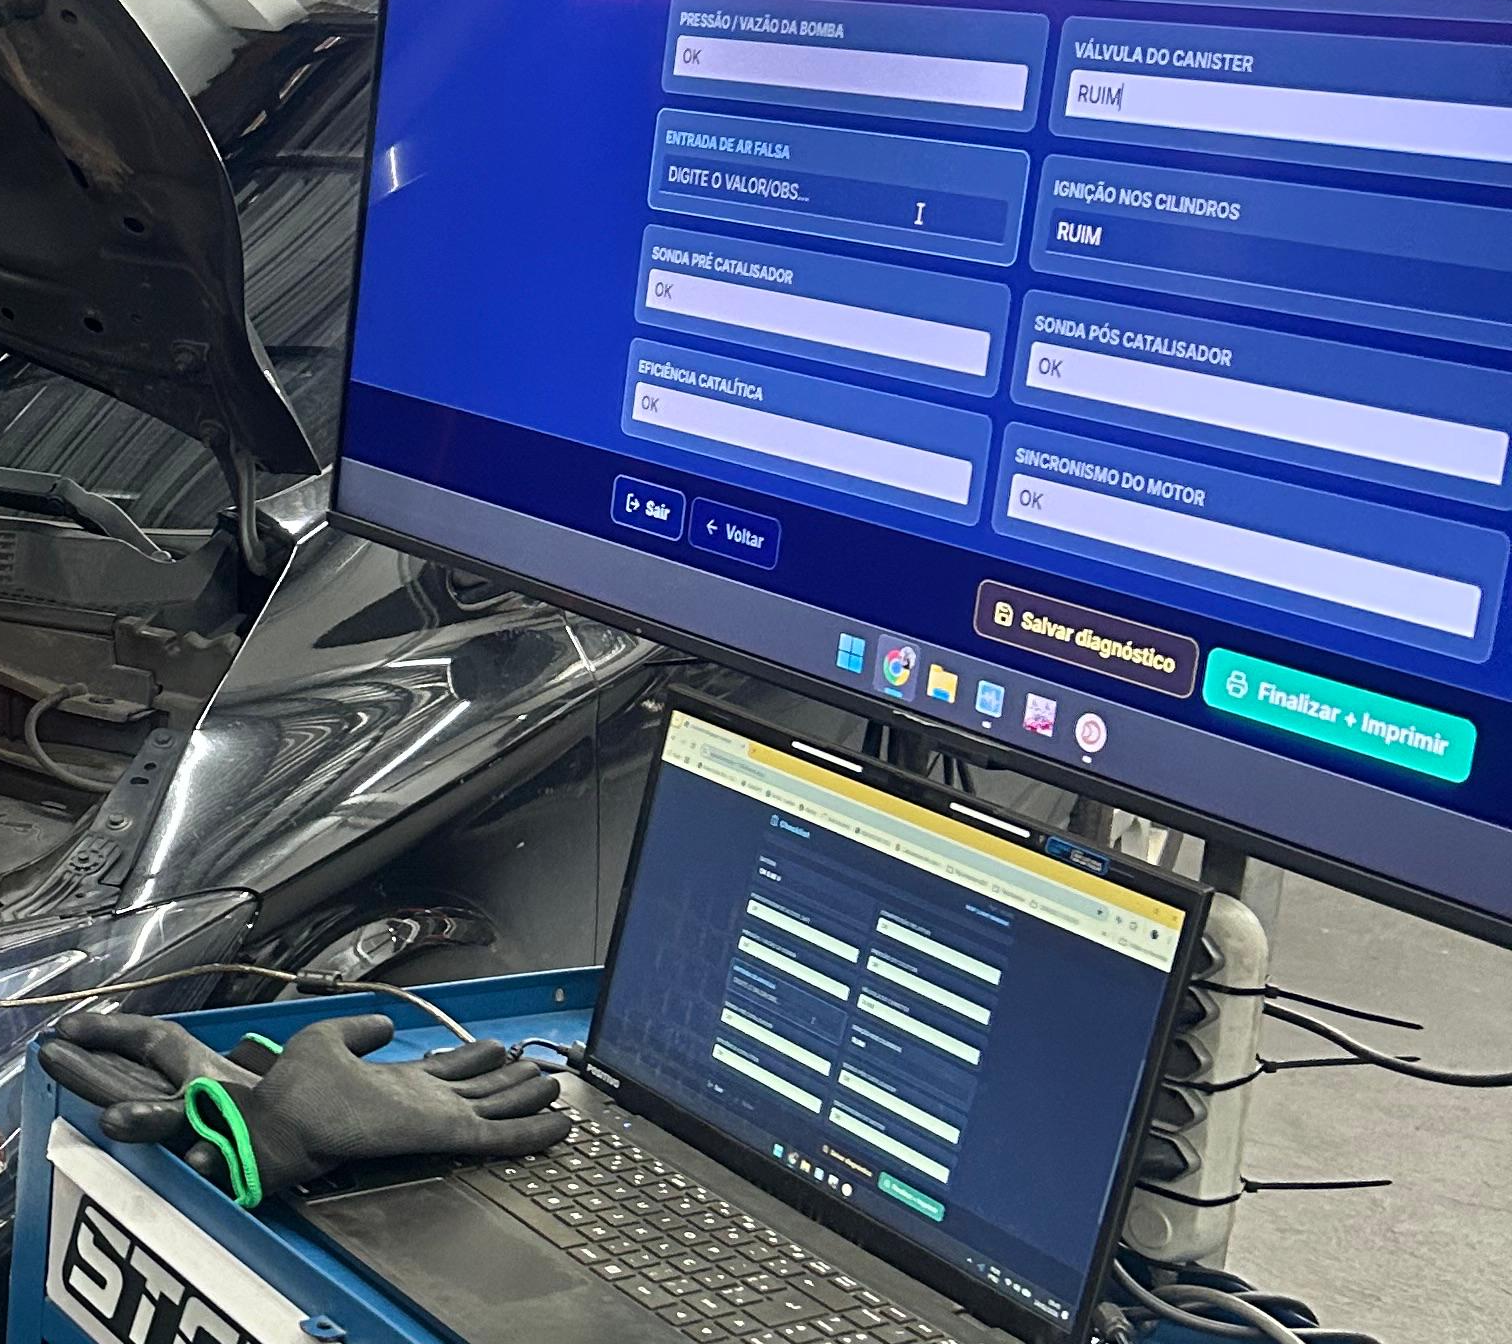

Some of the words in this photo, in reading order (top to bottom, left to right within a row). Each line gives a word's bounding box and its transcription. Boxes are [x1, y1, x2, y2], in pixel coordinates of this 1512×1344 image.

[679, 10, 731, 30] PRESSÃO
[738, 13, 778, 34] VAZÃO
[780, 18, 798, 35] DA
[799, 21, 844, 39] BOMBA
[682, 47, 701, 65] OK
[1075, 37, 1143, 64] VÁLVULA
[1145, 48, 1170, 66] DO
[1172, 49, 1254, 73] CANISTER
[1077, 83, 1123, 108] RUIM
[665, 129, 718, 151] ENTRADA
[718, 136, 734, 153] DE
[736, 138, 753, 155] AR
[753, 141, 791, 160] FALSA
[668, 165, 710, 188] DIGITE
[711, 171, 722, 189] O
[1054, 179, 1116, 205] IGNIÇÃO
[1118, 188, 1153, 209] NOS
[1155, 193, 1241, 221] CILINDROS
[1056, 220, 1103, 247] RUIM
[652, 246, 690, 266] SONDA
[691, 250, 714, 270] PRÉ
[714, 255, 793, 285] CATALISADOR
[654, 281, 674, 299] OK
[1034, 314, 1086, 340] SONDA
[1088, 322, 1120, 346] PÓS
[1122, 332, 1233, 367] CATALISADOR
[638, 359, 697, 386] EFICIÊNCIA
[698, 372, 763, 402] CATALÍTICA
[1038, 357, 1063, 378] OK
[641, 394, 660, 413] OK
[1015, 447, 1120, 487] SINCRONISMO
[1122, 471, 1145, 493] DO
[1147, 478, 1207, 507] MOTOR
[644, 501, 671, 522] Sair
[1019, 489, 1044, 511] OK
[725, 523, 764, 550] Voltar
[1020, 610, 1075, 642] Salvar
[1075, 625, 1177, 674] diagnóstico
[1256, 682, 1342, 726] Finalizar
[1361, 712, 1450, 758] Imprimir
